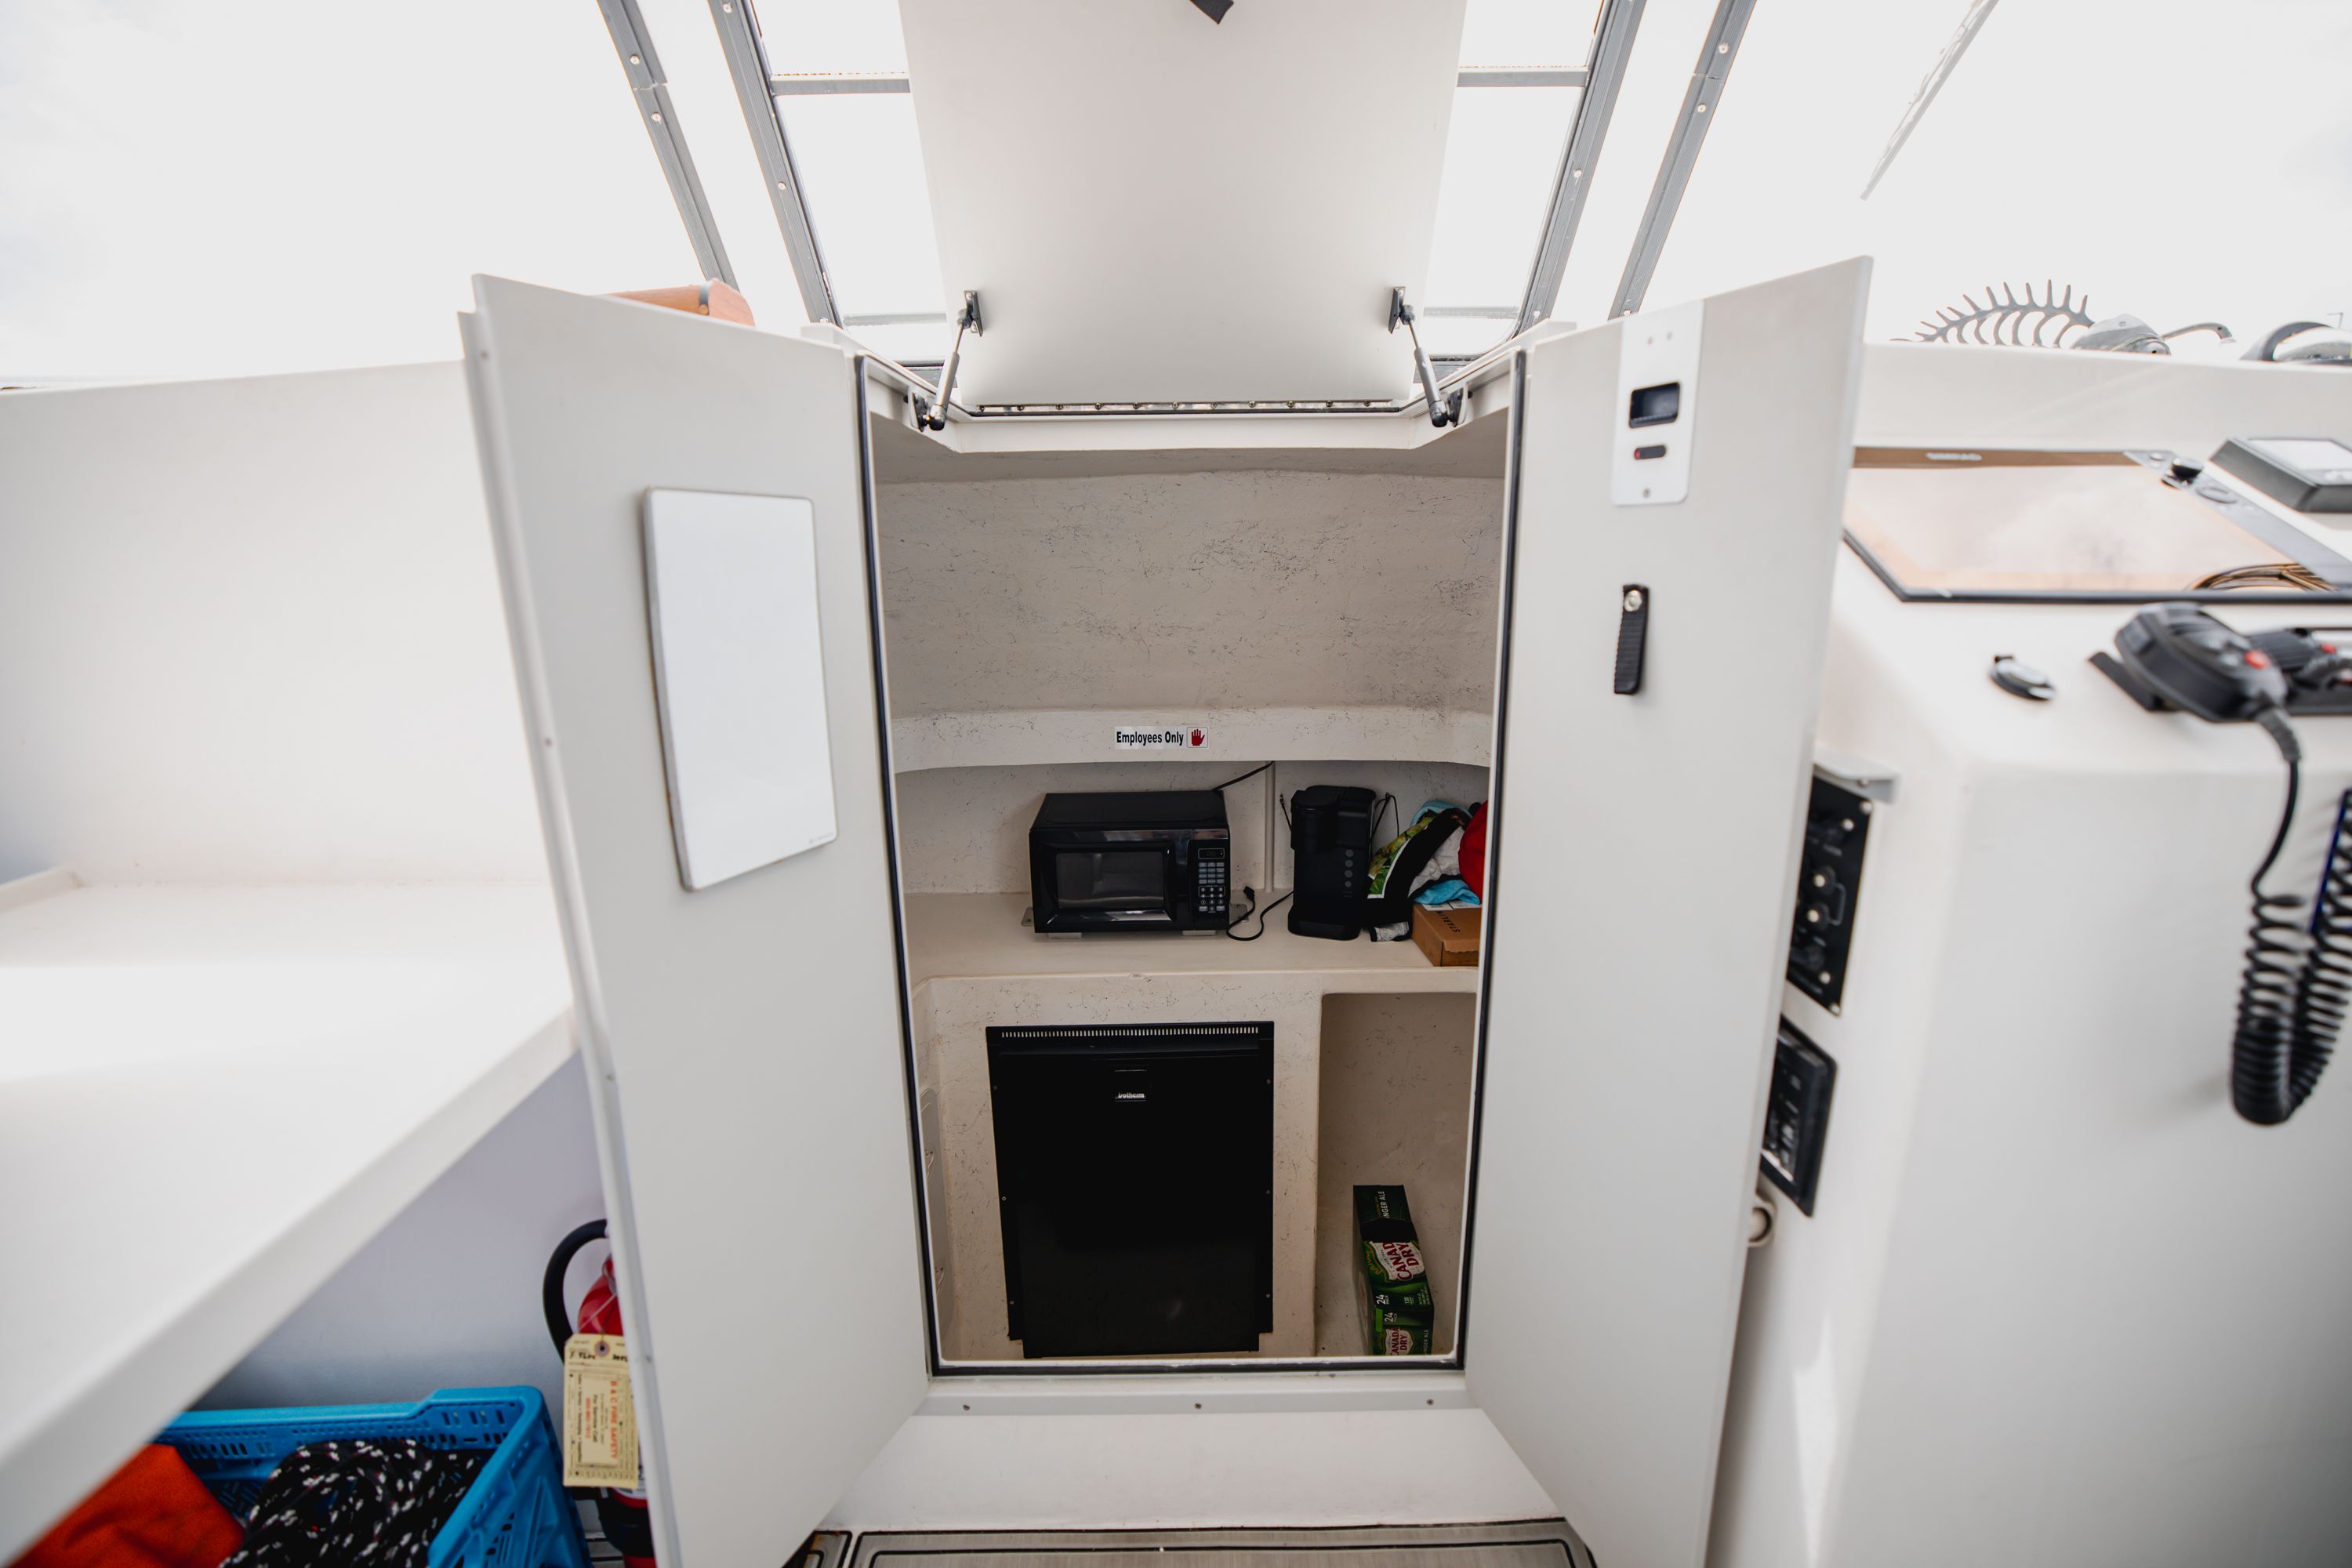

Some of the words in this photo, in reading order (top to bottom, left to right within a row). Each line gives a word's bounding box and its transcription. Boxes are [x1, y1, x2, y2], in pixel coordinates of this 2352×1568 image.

[1116, 731, 1163, 746] Employees
[1165, 731, 1184, 746] Only
[1377, 1191, 1387, 1200] ALE
[1382, 1242, 1412, 1279] CANAD
[1396, 1243, 1419, 1266] DRY
[1376, 1294, 1386, 1305] 24
[1385, 1312, 1394, 1323] 24
